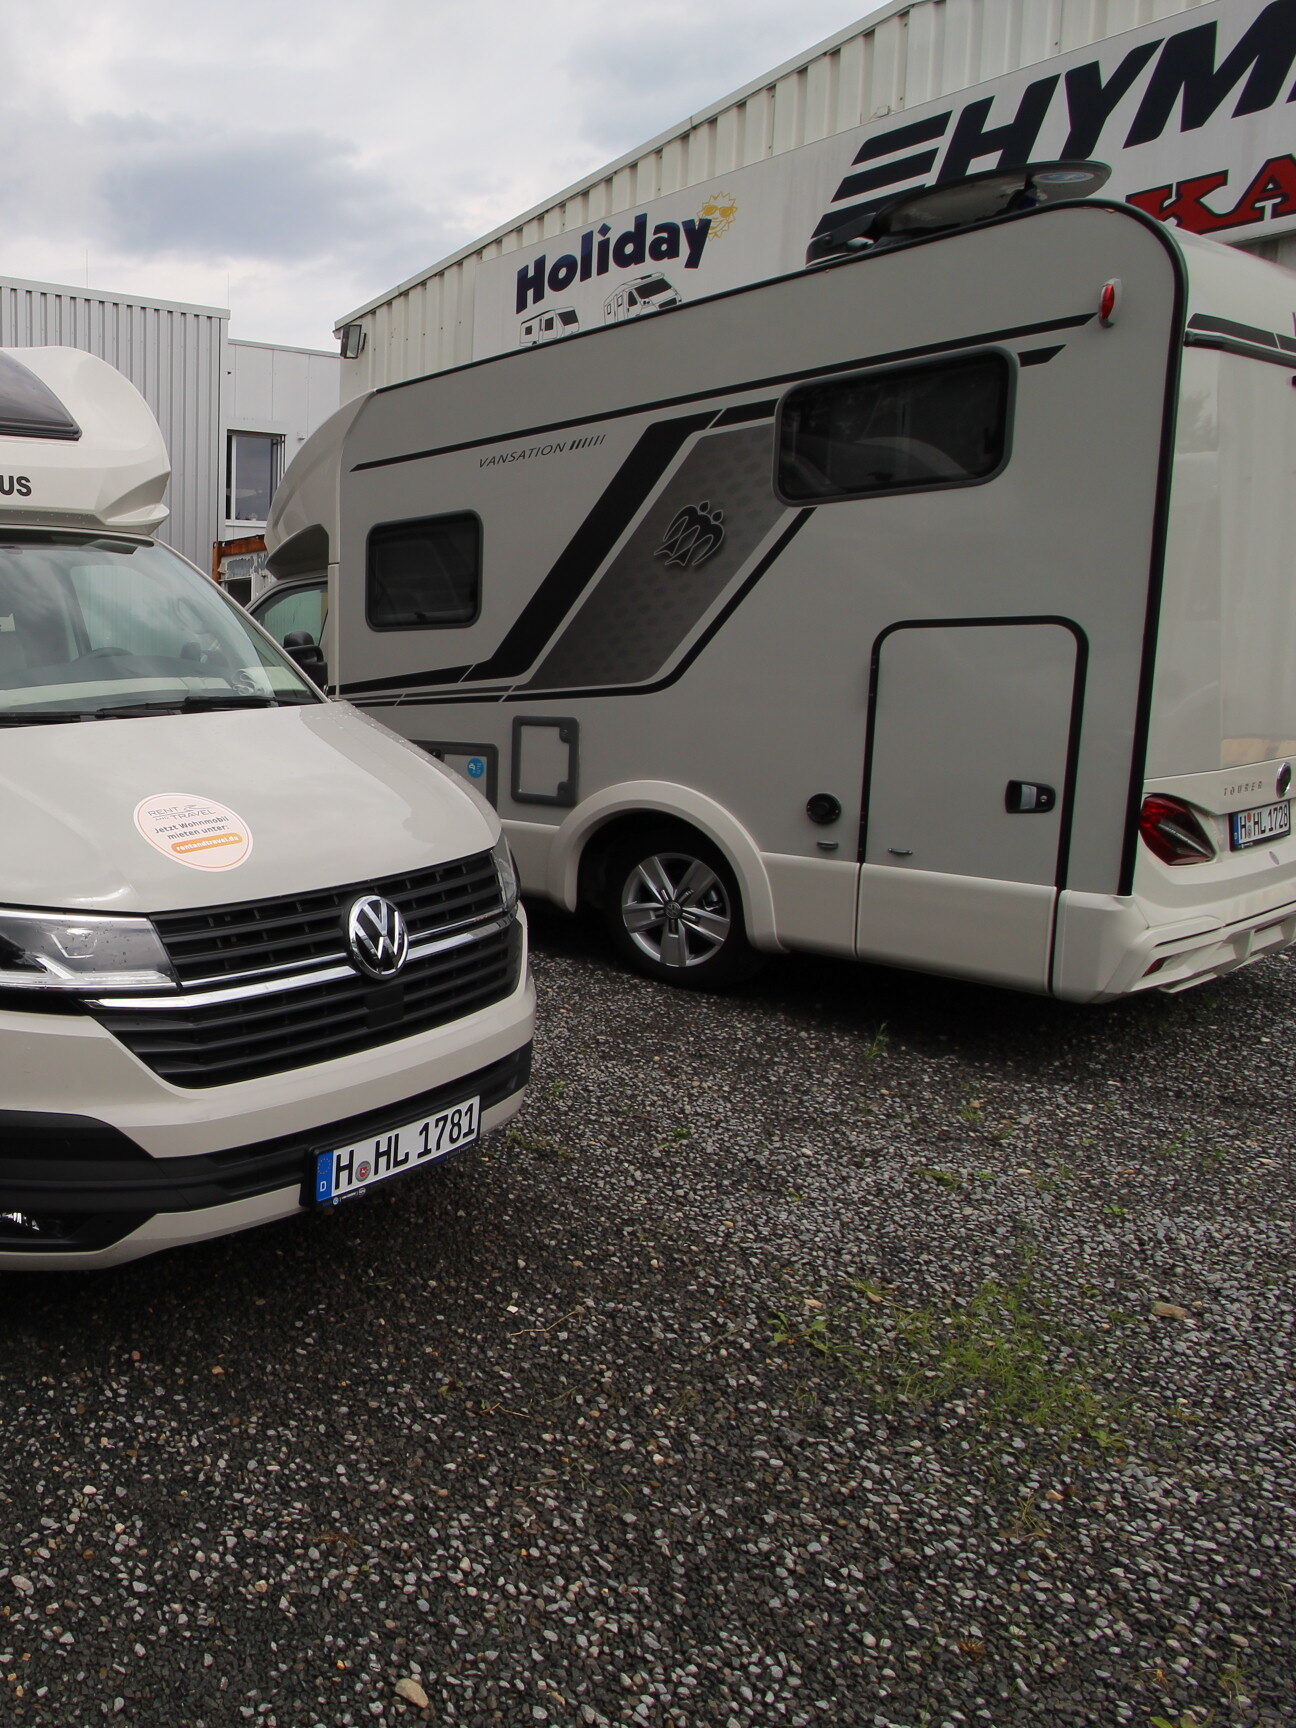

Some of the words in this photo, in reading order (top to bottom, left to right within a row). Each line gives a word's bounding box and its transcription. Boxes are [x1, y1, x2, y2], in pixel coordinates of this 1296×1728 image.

[935, 0, 1296, 190] HYM
[516, 212, 712, 315] Holiday
[479, 442, 567, 468] VANSATION
[1223, 780, 1263, 797] TOURER
[147, 806, 180, 816] RENT
[170, 808, 217, 820] TRAVEL
[154, 823, 179, 834] Jetzt
[178, 815, 230, 830] Wohnmobil
[1239, 815, 1247, 840] H
[1253, 811, 1266, 836] HL
[1267, 804, 1288, 832] 1728
[166, 829, 201, 840] mieten
[201, 824, 230, 834] unter:
[176, 836, 240, 851] rentandtravel.de
[334, 1150, 354, 1190] H
[373, 1133, 409, 1176] HL
[417, 1102, 475, 1159] 1781
[320, 1181, 327, 1192] D
